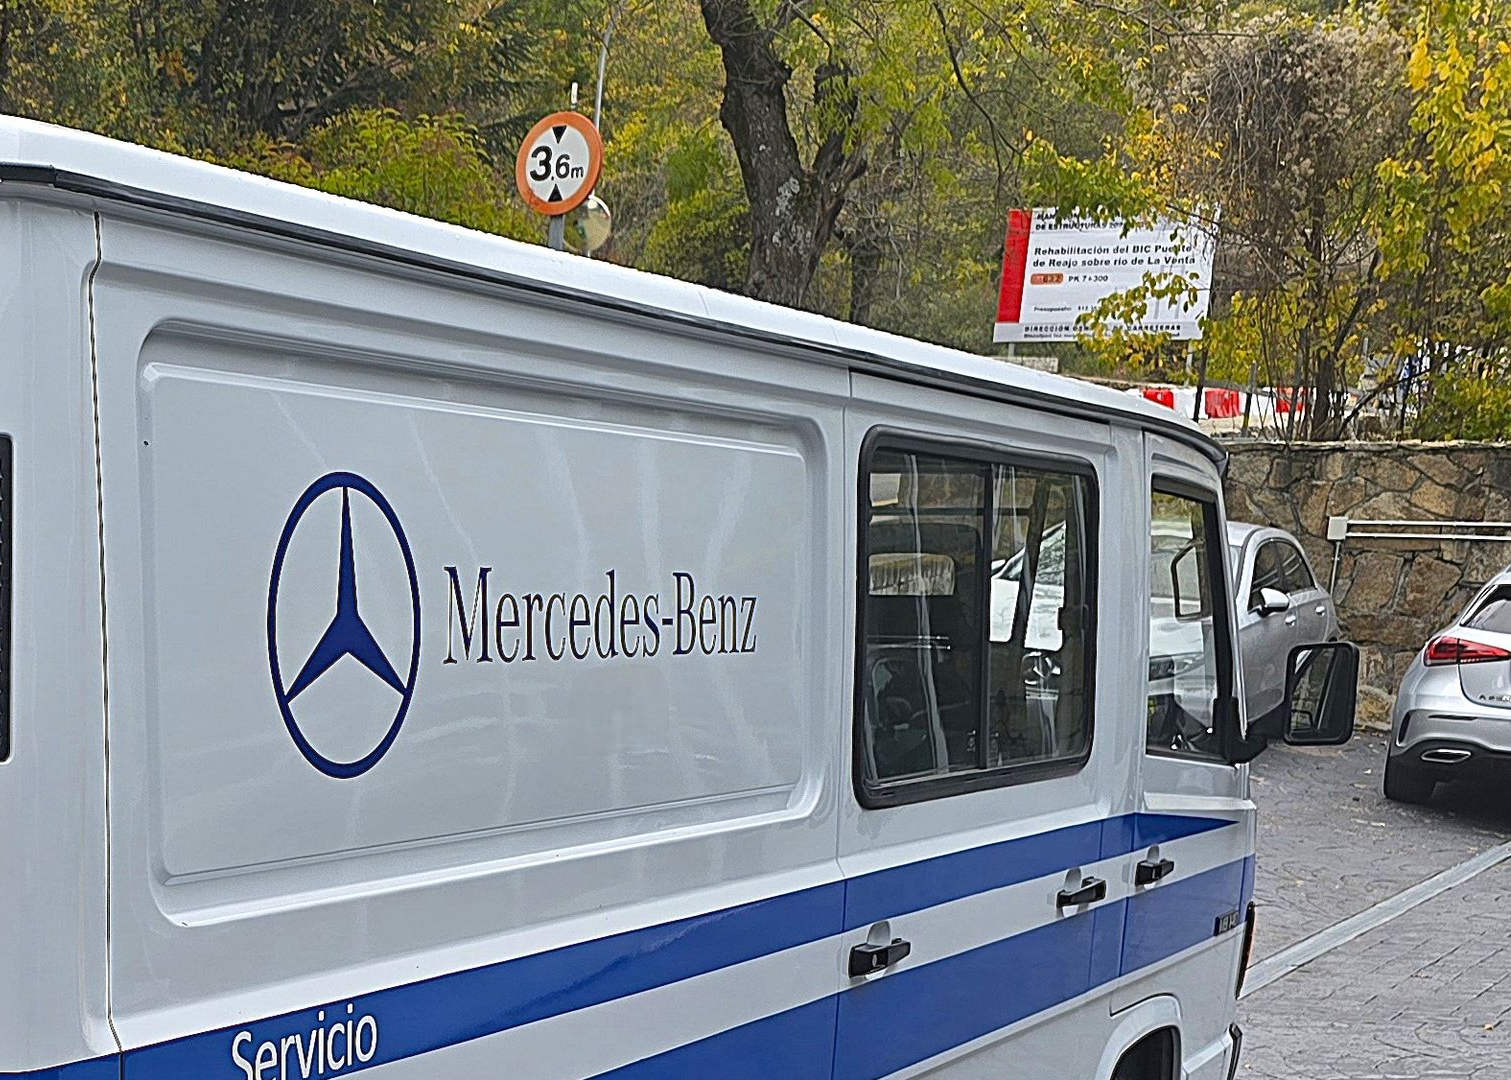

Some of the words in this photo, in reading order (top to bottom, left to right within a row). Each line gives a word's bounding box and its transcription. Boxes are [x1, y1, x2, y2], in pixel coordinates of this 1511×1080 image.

[1034, 245, 1110, 256] Rehabilitación
[1113, 244, 1129, 254] del
[1132, 245, 1151, 254] BIC
[1032, 258, 1045, 267] de
[1048, 258, 1078, 269] Reajo
[1081, 257, 1110, 266] sobre
[1131, 256, 1144, 265] de
[1147, 256, 1160, 265] La
[1164, 256, 1195, 265] Venta
[443, 566, 758, 665] Mercedes-Benz
